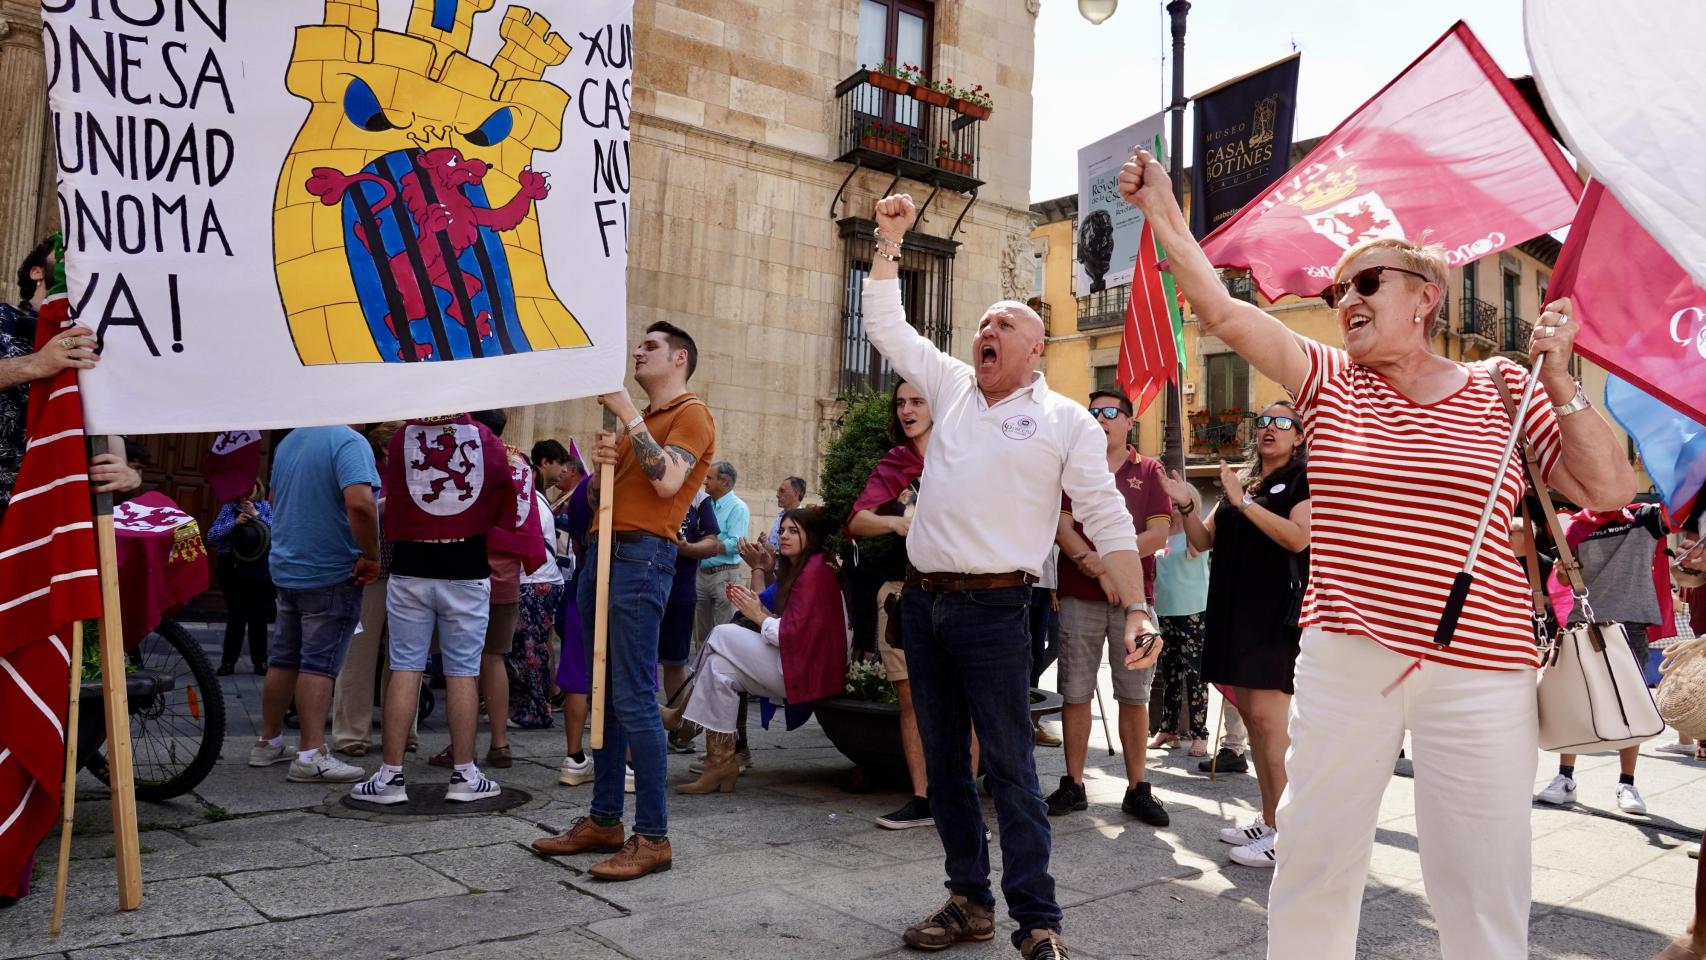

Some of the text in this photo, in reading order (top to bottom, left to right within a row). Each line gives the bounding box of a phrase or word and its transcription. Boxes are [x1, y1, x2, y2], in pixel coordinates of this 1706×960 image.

[579, 23, 632, 71] XU
[50, 110, 235, 187] UNIDAD
[1206, 140, 1246, 166] CASA
[1206, 144, 1273, 183] BOTINES
